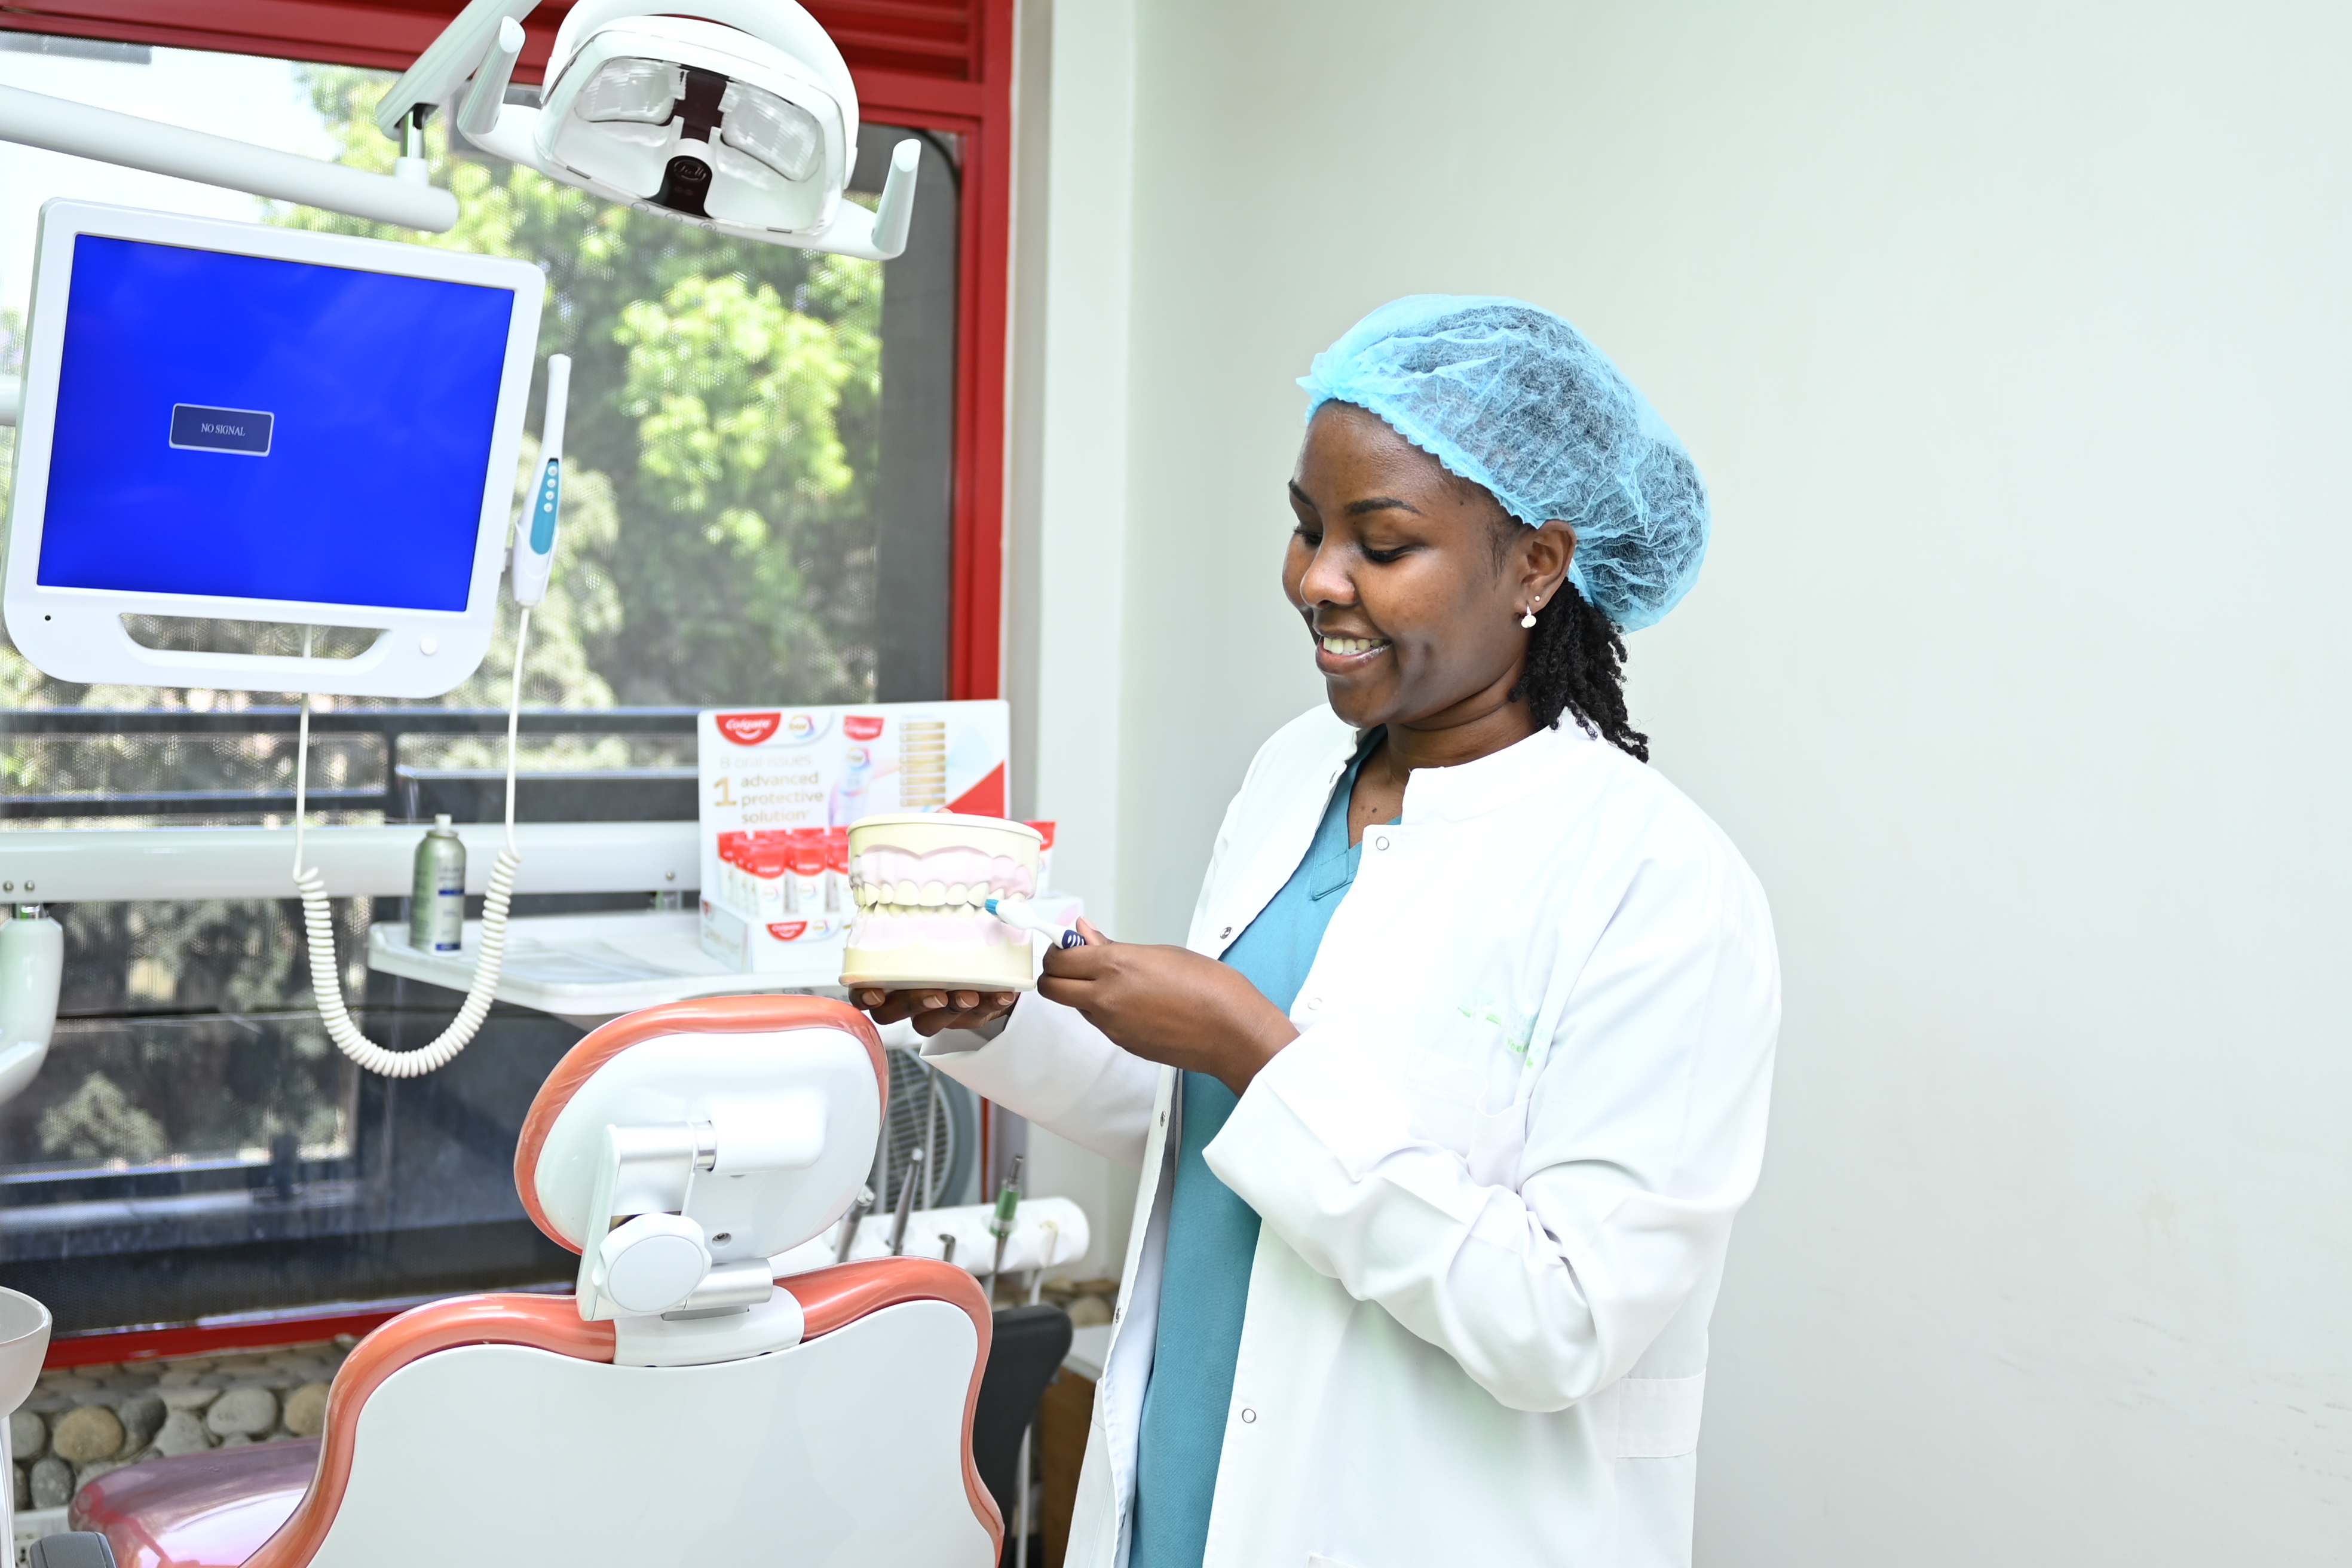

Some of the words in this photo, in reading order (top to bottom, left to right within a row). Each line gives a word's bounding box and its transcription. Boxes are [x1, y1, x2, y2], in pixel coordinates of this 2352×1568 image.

[201, 422, 214, 433] NO
[216, 424, 245, 436] SIGNAL
[725, 718, 771, 731] Colgate
[720, 755, 730, 770] 8
[734, 754, 763, 768] oral
[768, 754, 811, 767] issues
[741, 770, 819, 788] advanced
[713, 776, 737, 807] 1
[742, 789, 825, 809] protective
